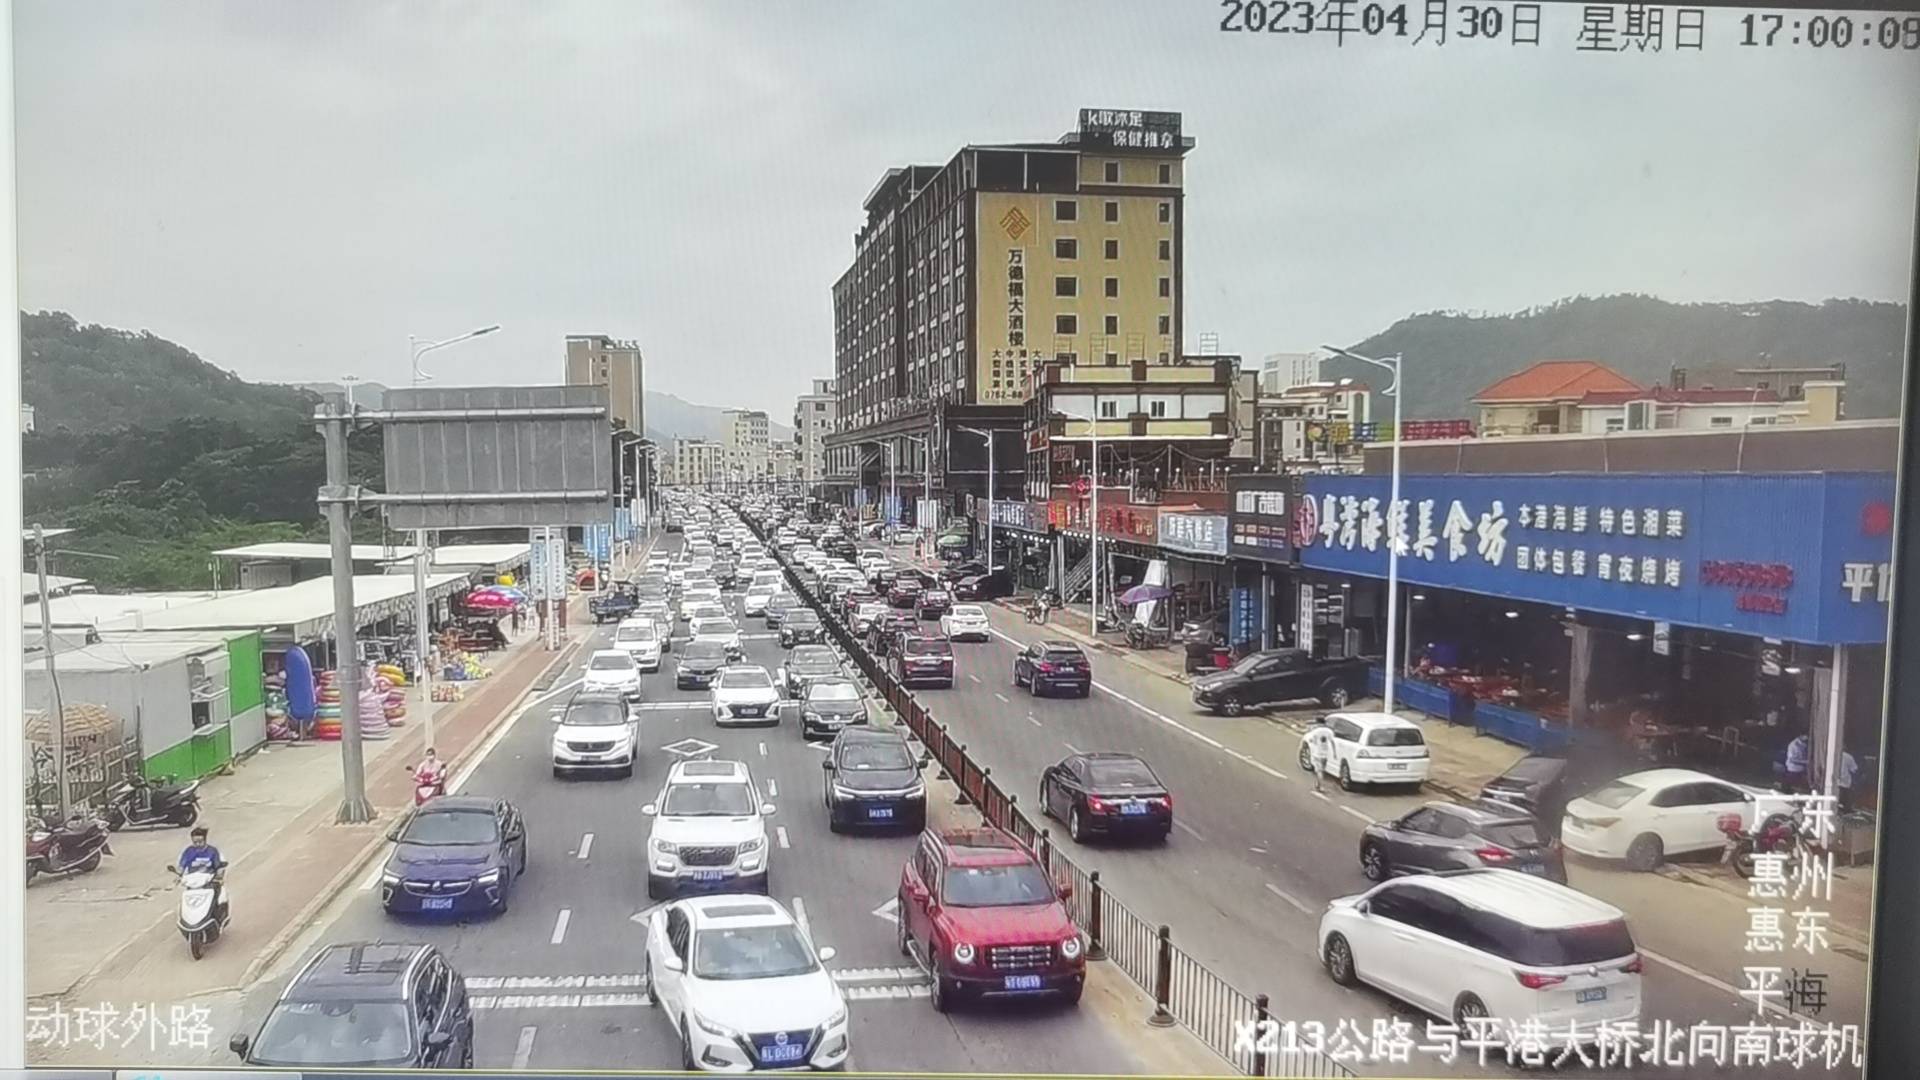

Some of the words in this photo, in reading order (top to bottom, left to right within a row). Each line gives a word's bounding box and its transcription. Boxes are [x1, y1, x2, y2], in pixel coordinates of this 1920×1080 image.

[1112, 130, 1173, 148] 保健推拿
[1599, 506, 1683, 537] 特色湘菜
[1597, 553, 1681, 587] 宵夜烧烤
